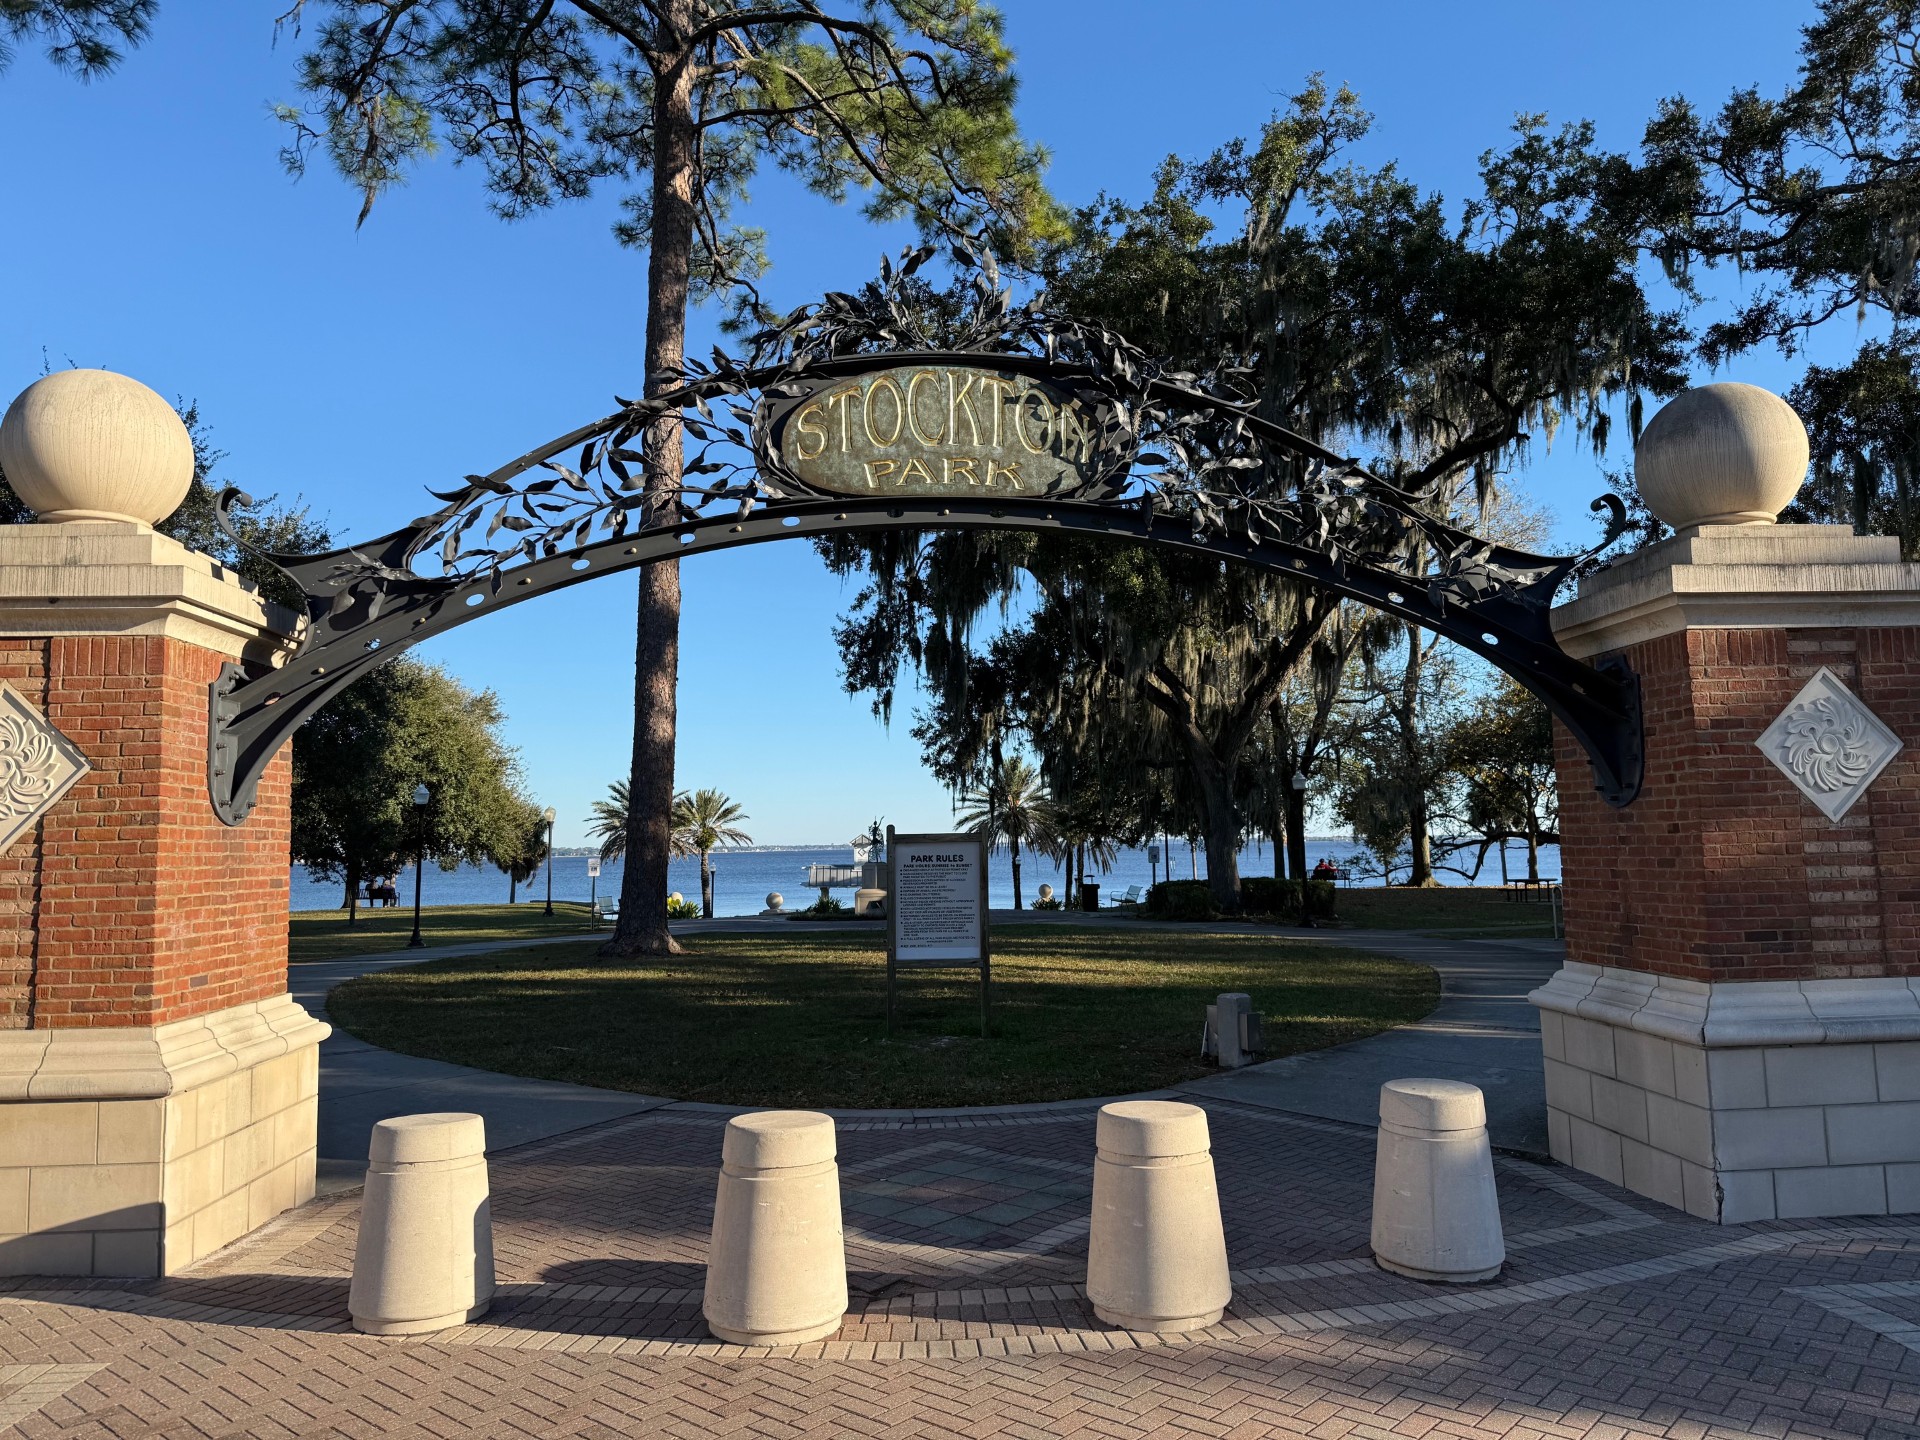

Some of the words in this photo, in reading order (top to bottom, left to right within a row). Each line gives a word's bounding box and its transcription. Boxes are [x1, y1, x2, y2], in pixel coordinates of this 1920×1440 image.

[796, 370, 1090, 464] STOCKTON
[863, 457, 1026, 490] PARK
[910, 854, 934, 863] PARK
[936, 854, 964, 863] RULES
